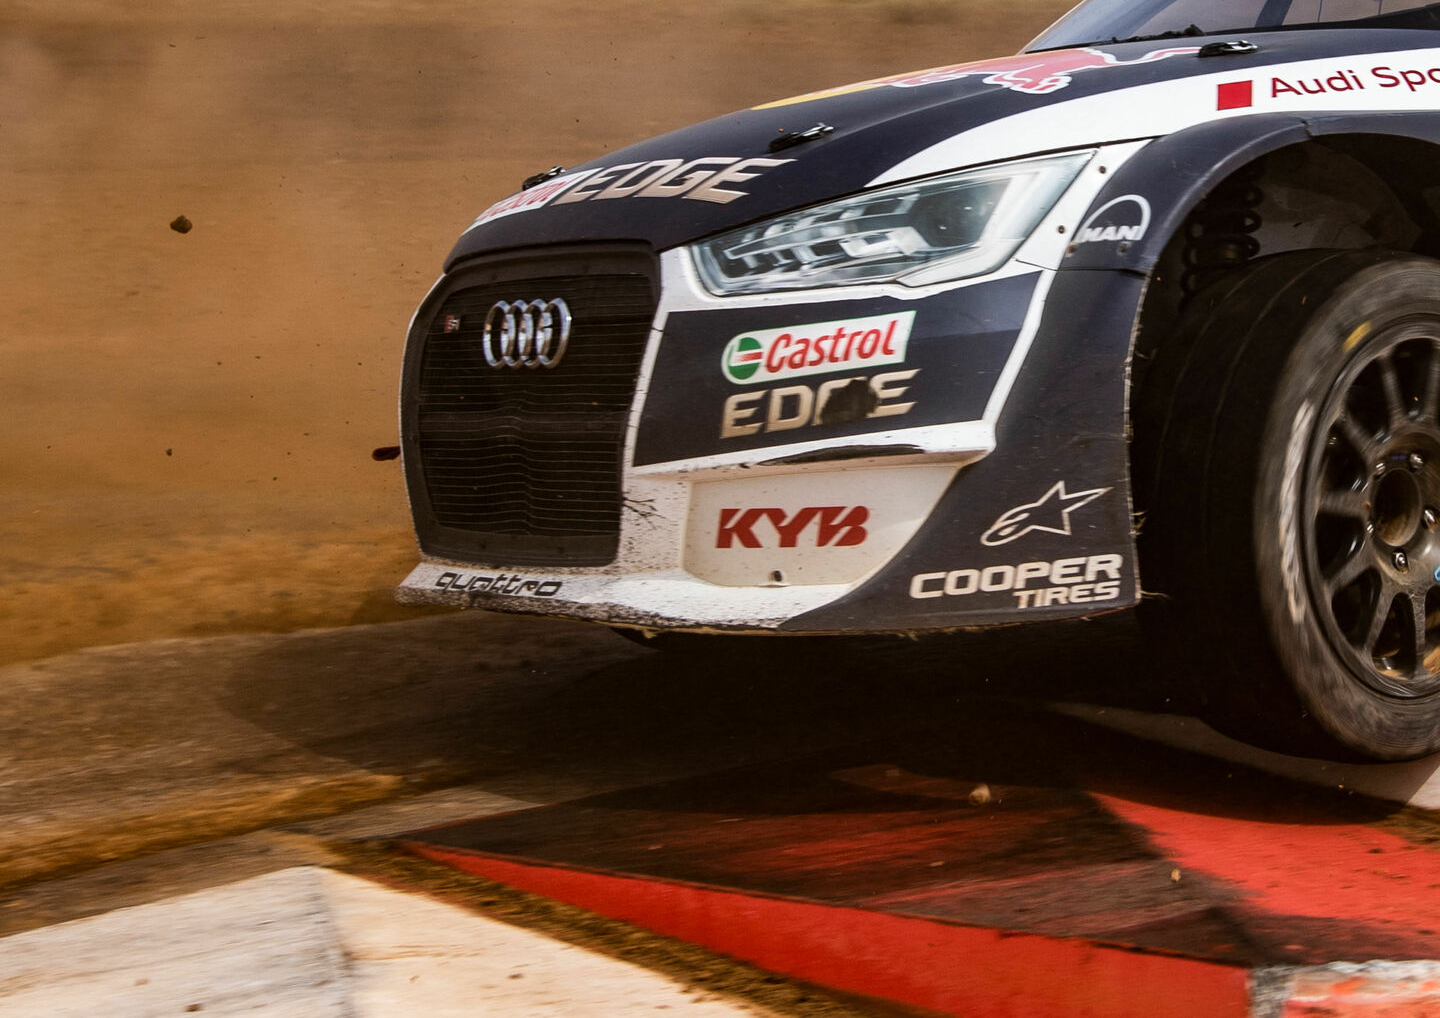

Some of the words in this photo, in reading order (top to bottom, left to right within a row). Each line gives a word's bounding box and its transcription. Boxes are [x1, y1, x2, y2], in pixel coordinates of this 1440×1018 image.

[1270, 68, 1365, 99] Audi
[549, 156, 798, 205] EDGE
[1073, 225, 1142, 244] MAN
[764, 319, 899, 374] Castrol
[714, 505, 871, 549] KYB
[434, 571, 563, 597] quattro
[908, 553, 1124, 600] COOPER
[1012, 580, 1121, 609] TIRES
